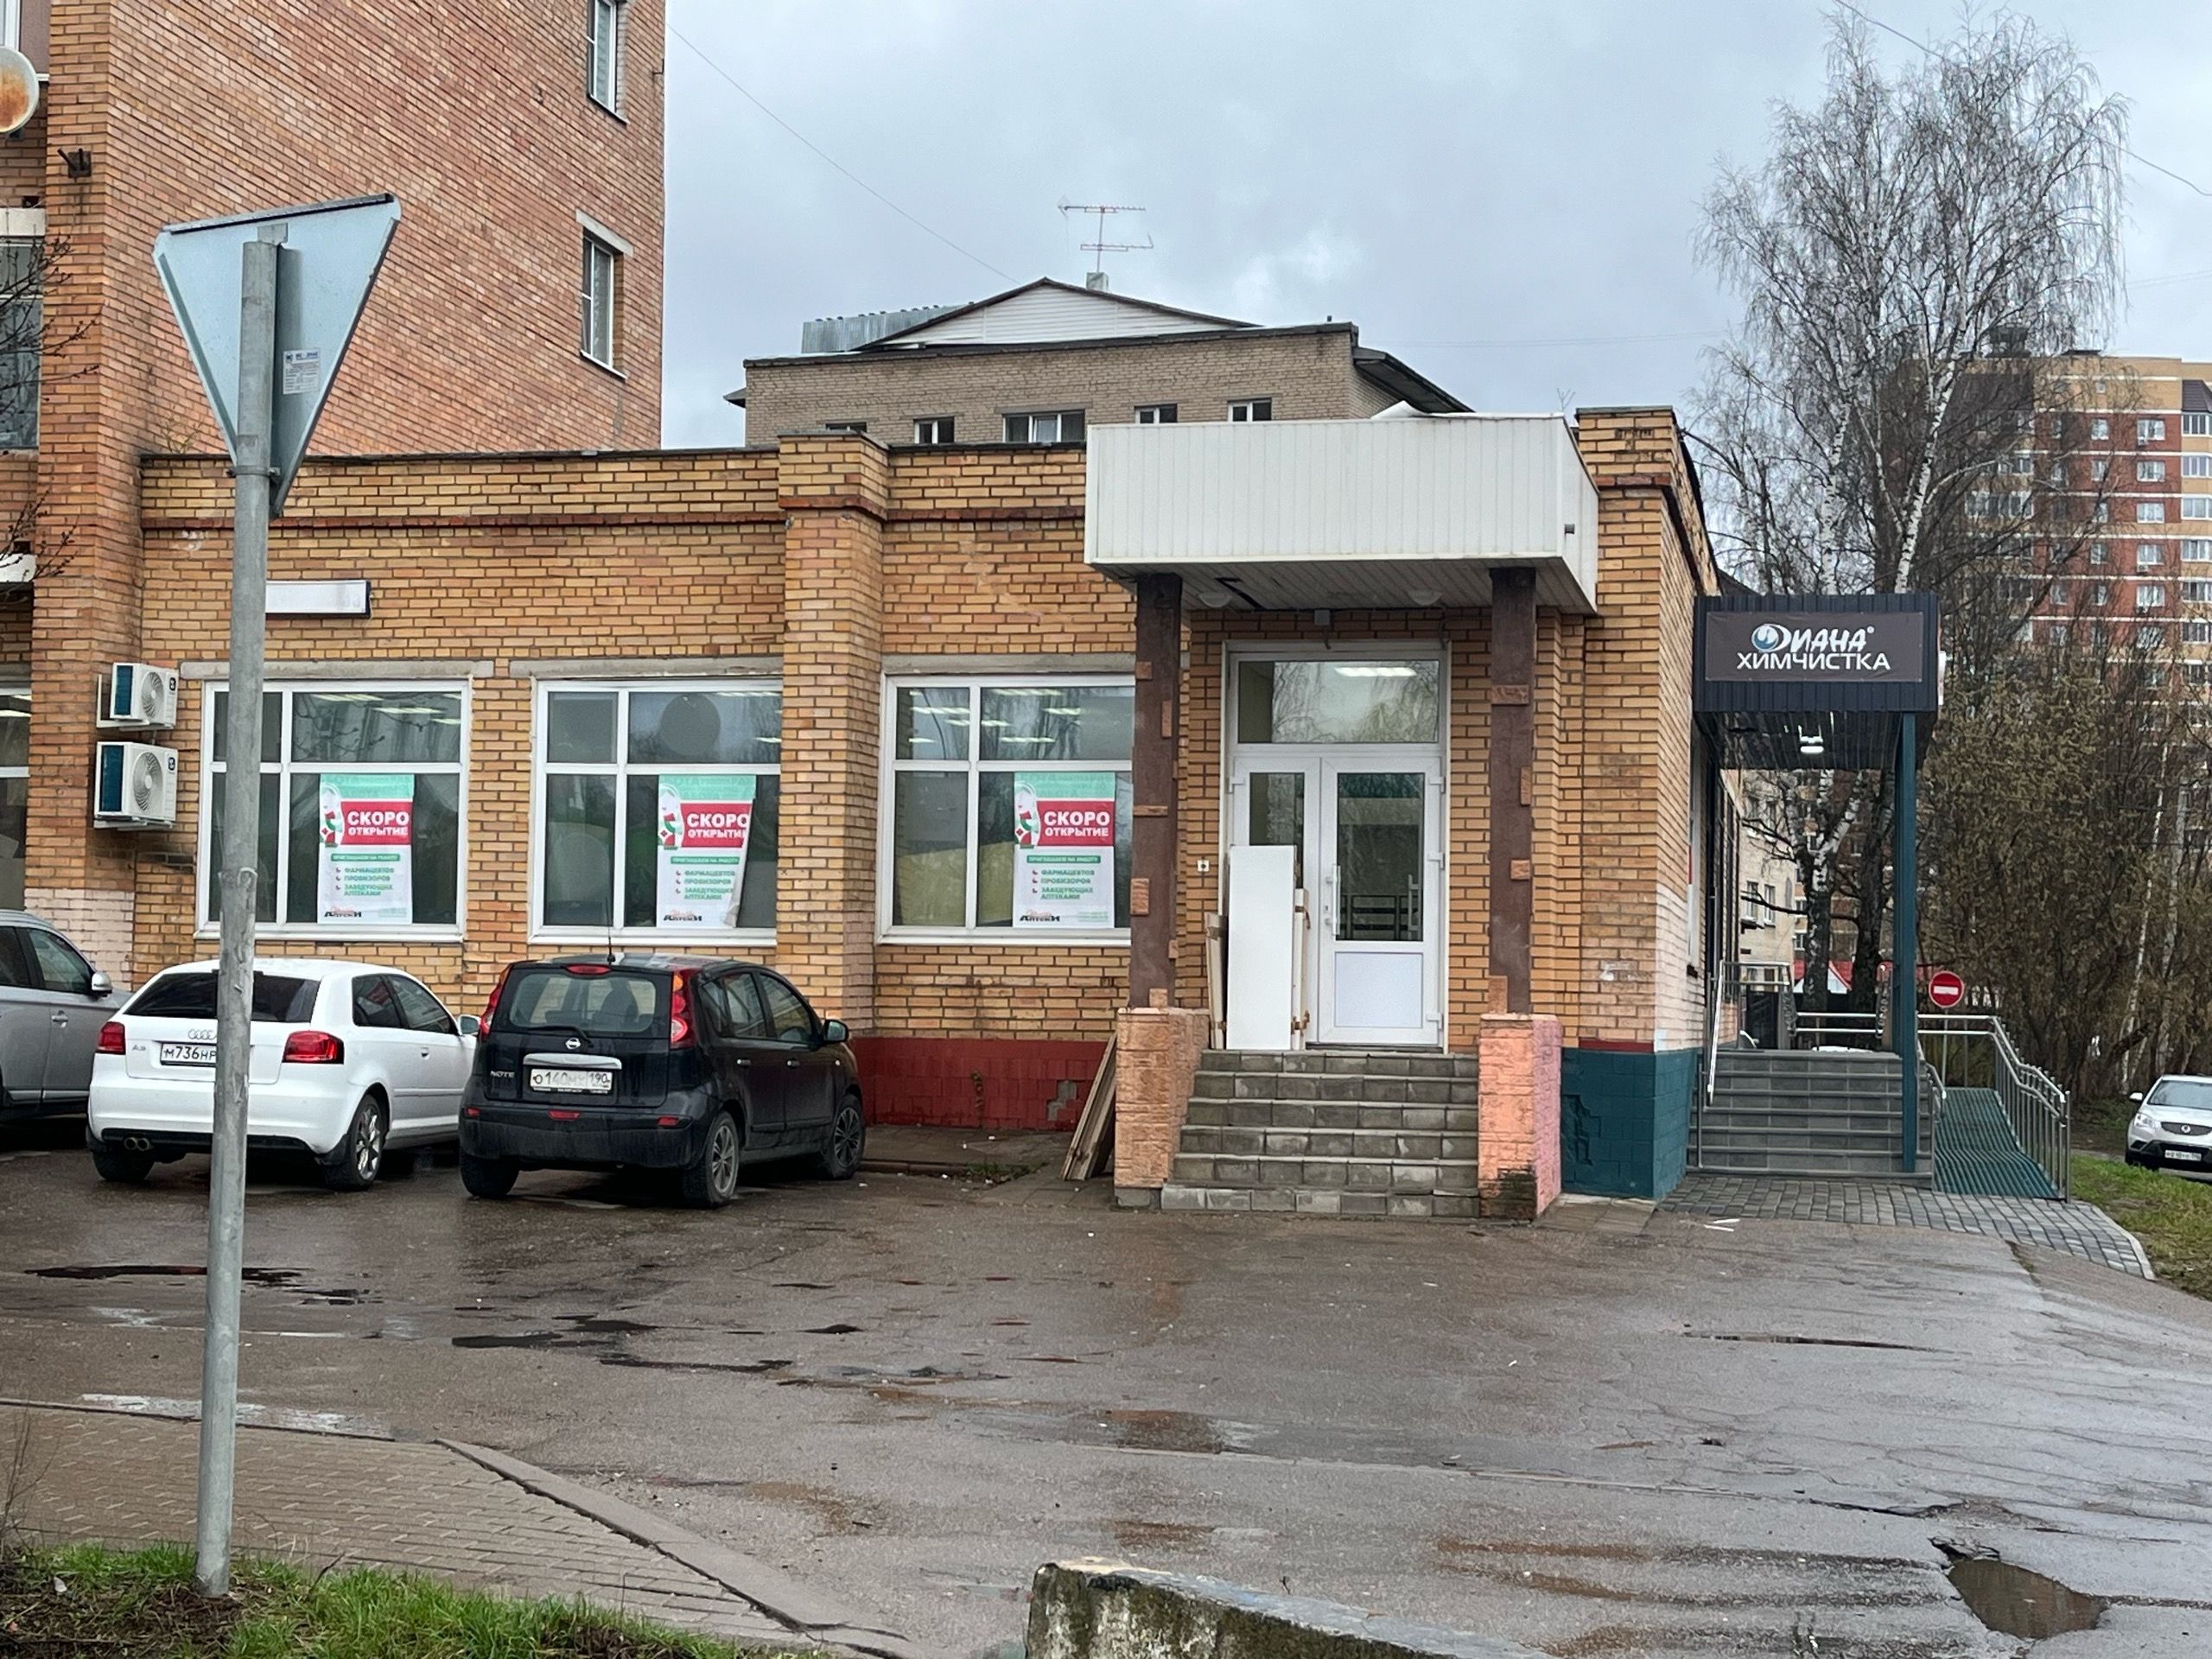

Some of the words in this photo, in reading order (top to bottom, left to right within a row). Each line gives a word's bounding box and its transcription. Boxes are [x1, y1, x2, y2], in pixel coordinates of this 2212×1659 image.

[1737, 652, 1891, 671] ХИМЧИСТКА
[347, 811, 410, 826] СКОРО
[686, 813, 749, 828] СКОРО
[1044, 811, 1110, 826] СКОРО
[348, 827, 409, 836] ОТКРЫТИЕ
[1045, 827, 1109, 837] ОТКРЫТИЕ
